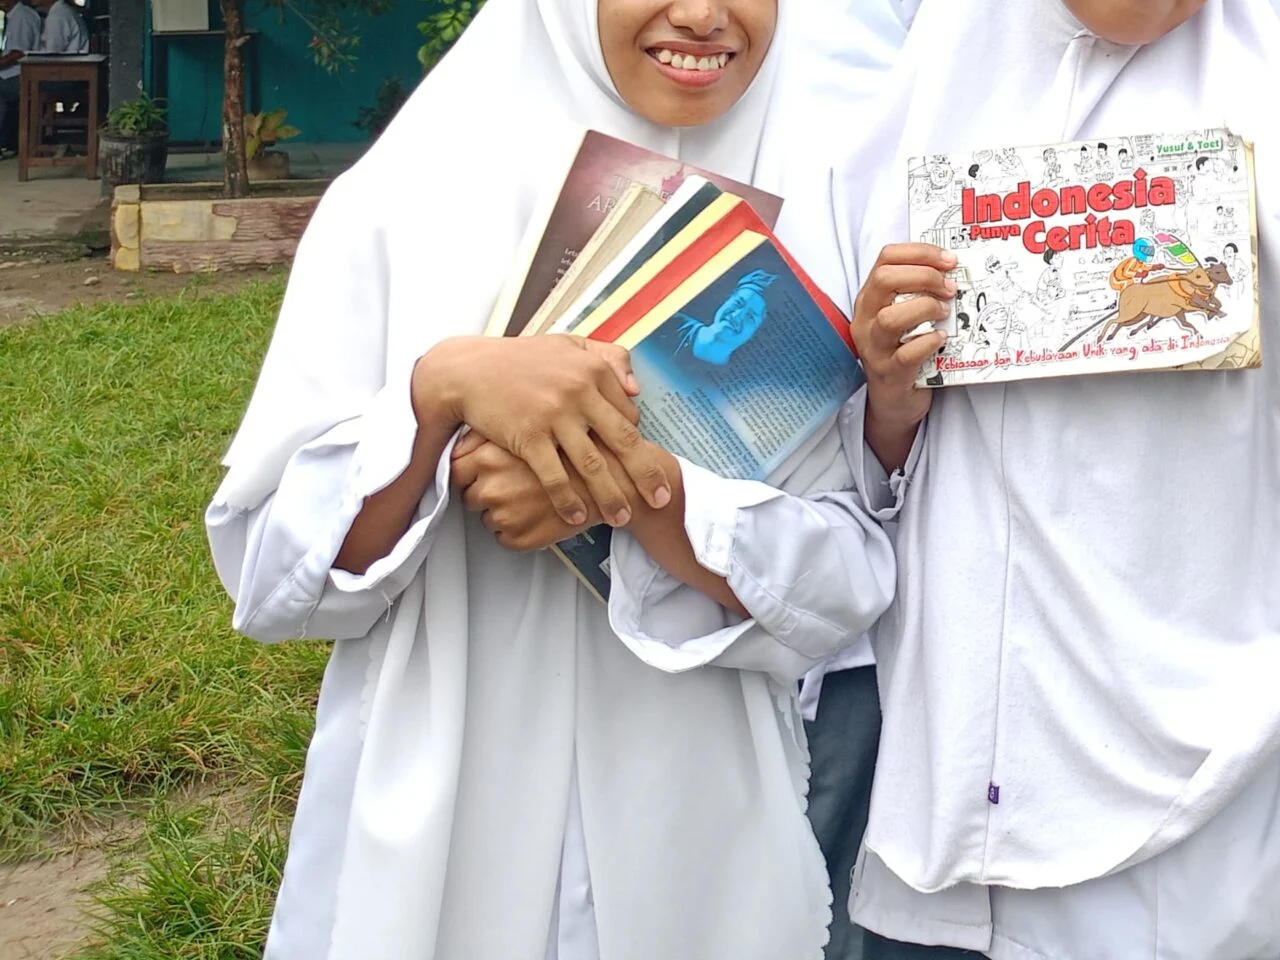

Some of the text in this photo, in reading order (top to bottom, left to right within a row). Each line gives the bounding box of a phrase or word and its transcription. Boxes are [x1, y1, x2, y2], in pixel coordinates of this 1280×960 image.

[1156, 143, 1184, 154] Yusuf
[1187, 142, 1195, 151] &
[961, 167, 1176, 226] Indonesia
[970, 213, 1136, 255] Punya Cerita
[936, 356, 989, 372] Kebiasaan
[993, 352, 1011, 366] dan
[1083, 343, 1106, 358] Unik
[1109, 344, 1136, 362] yang
[1142, 338, 1163, 353] ada
